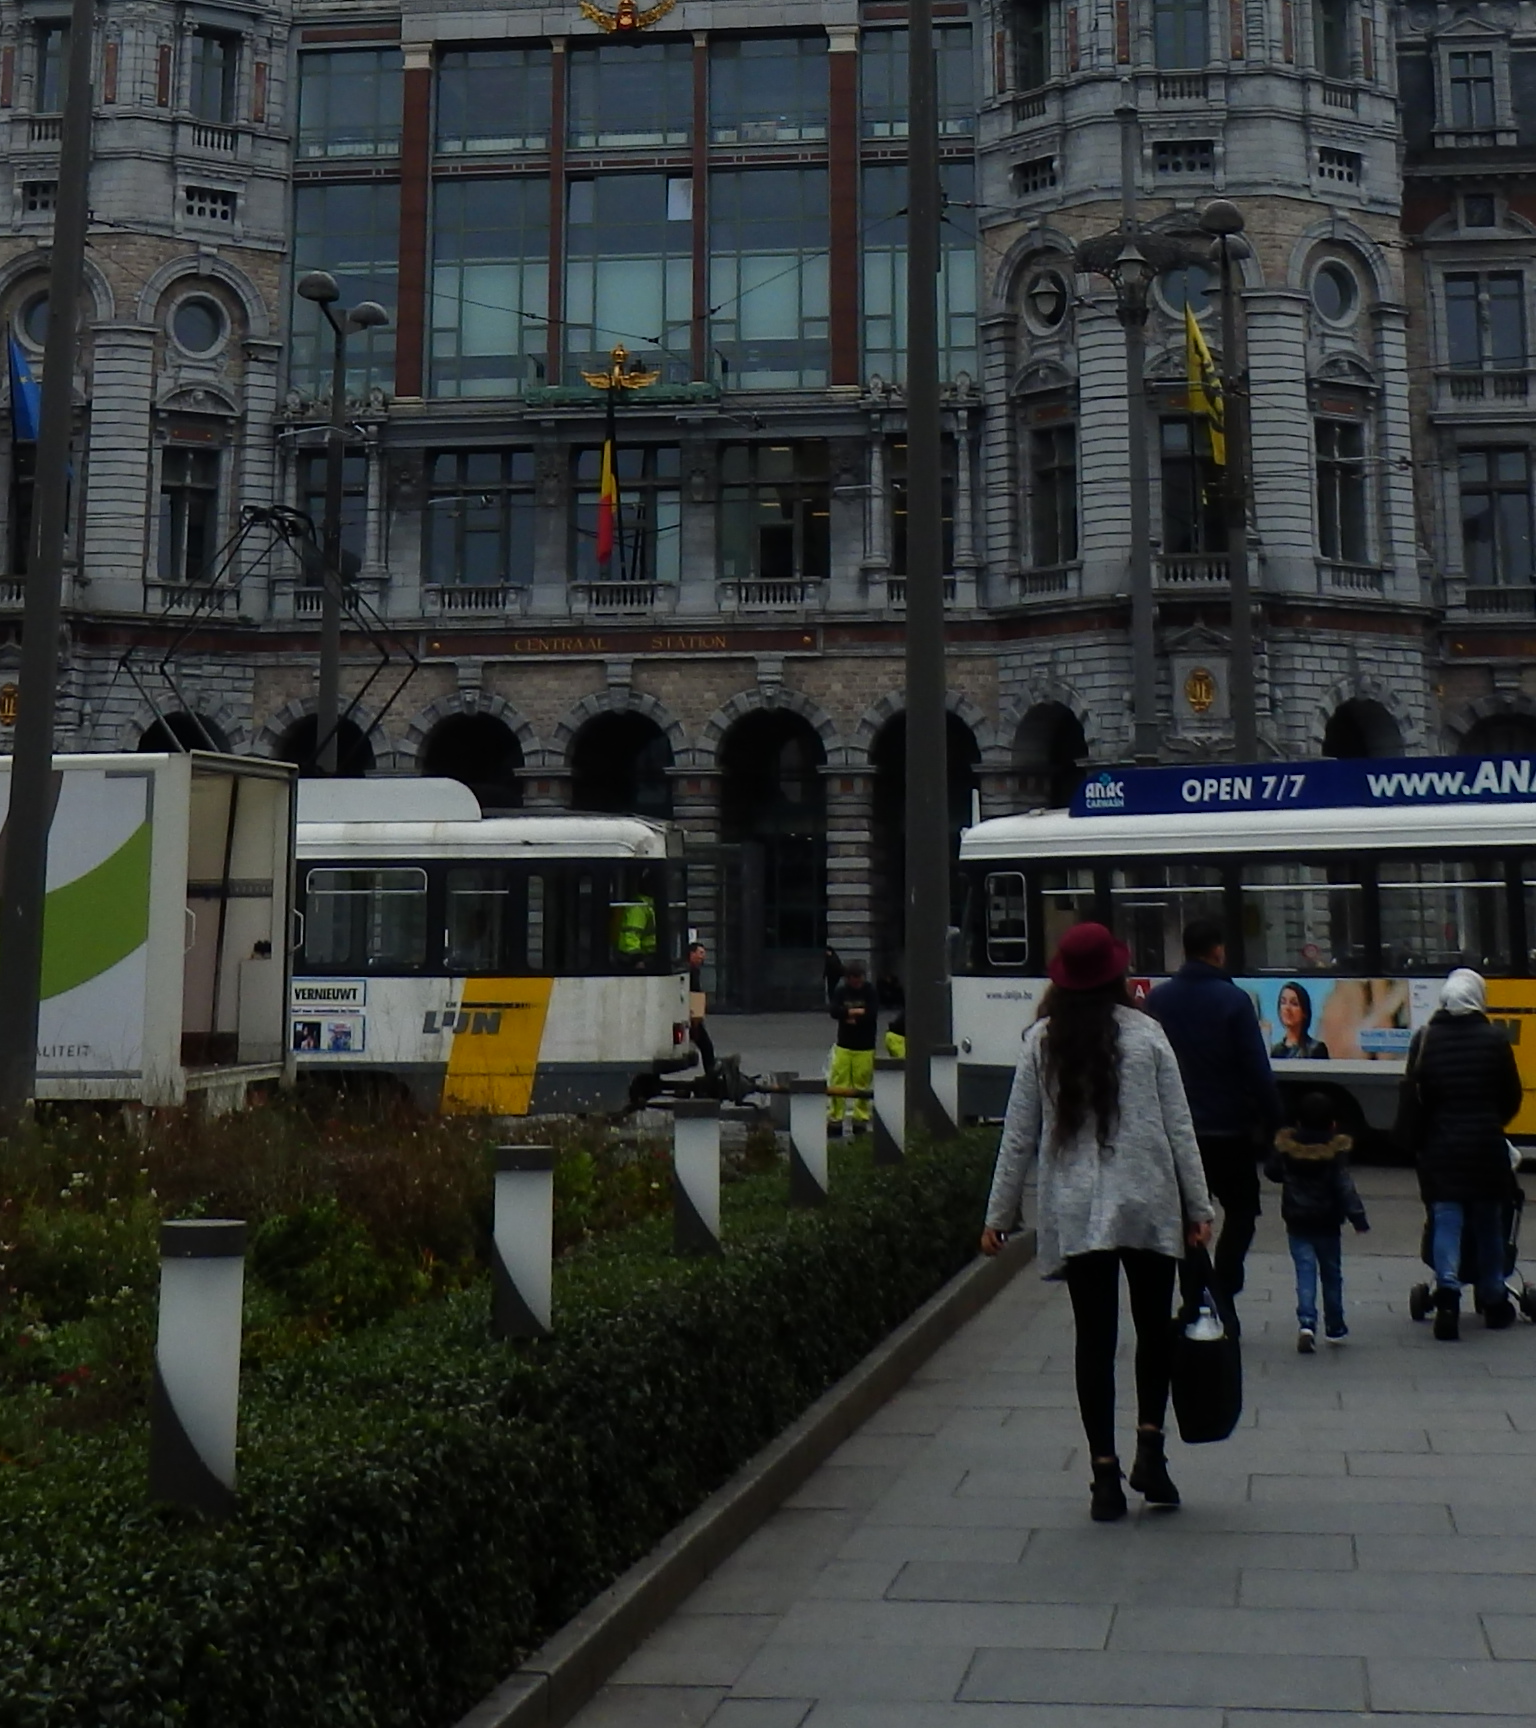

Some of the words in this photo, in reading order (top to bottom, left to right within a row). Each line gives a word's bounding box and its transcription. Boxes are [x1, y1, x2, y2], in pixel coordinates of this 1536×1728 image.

[515, 638, 607, 652] CENTRAAL
[651, 635, 727, 650] STATION
[1181, 776, 1253, 803] OPEN
[1261, 774, 1306, 801] 7/7
[1086, 798, 1125, 809] CARWASH
[294, 988, 358, 1000] VERNIEUWT
